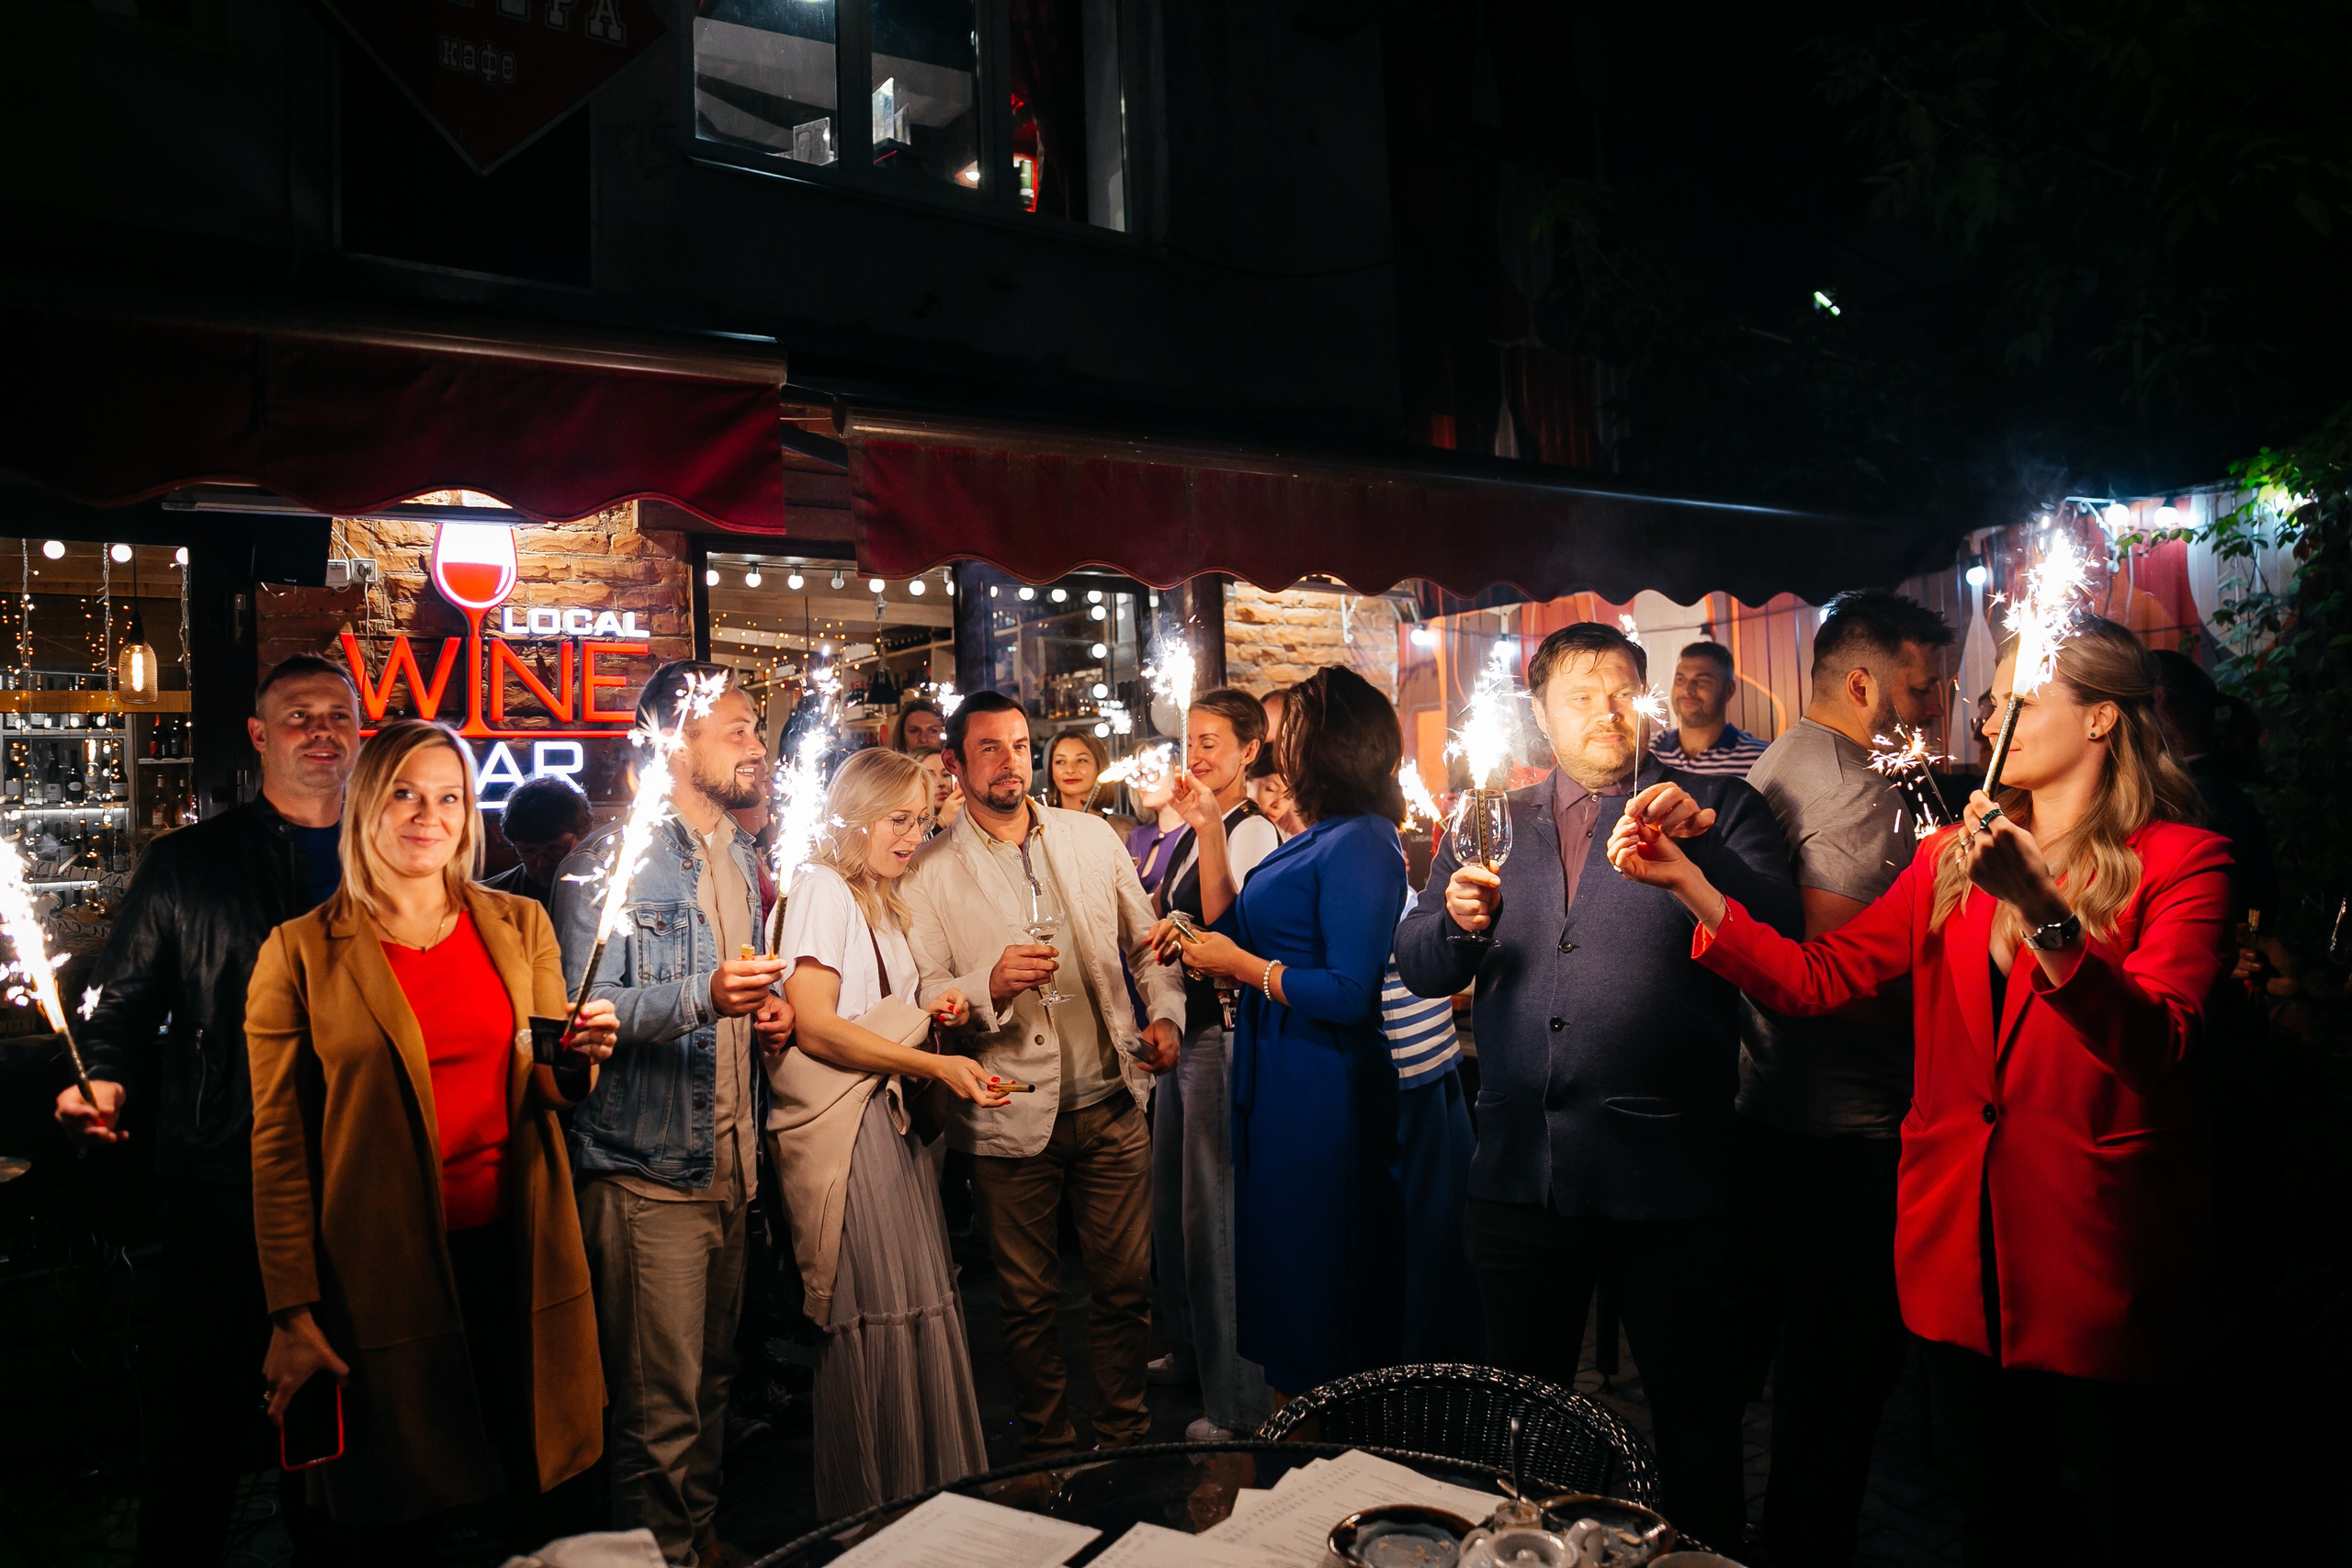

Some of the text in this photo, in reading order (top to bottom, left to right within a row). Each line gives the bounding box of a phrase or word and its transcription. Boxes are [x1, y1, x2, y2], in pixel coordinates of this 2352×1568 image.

[440, 35, 517, 85] кафе
[502, 607, 650, 637] LOCAL
[340, 632, 650, 724] WINE
[474, 740, 585, 795] AR
